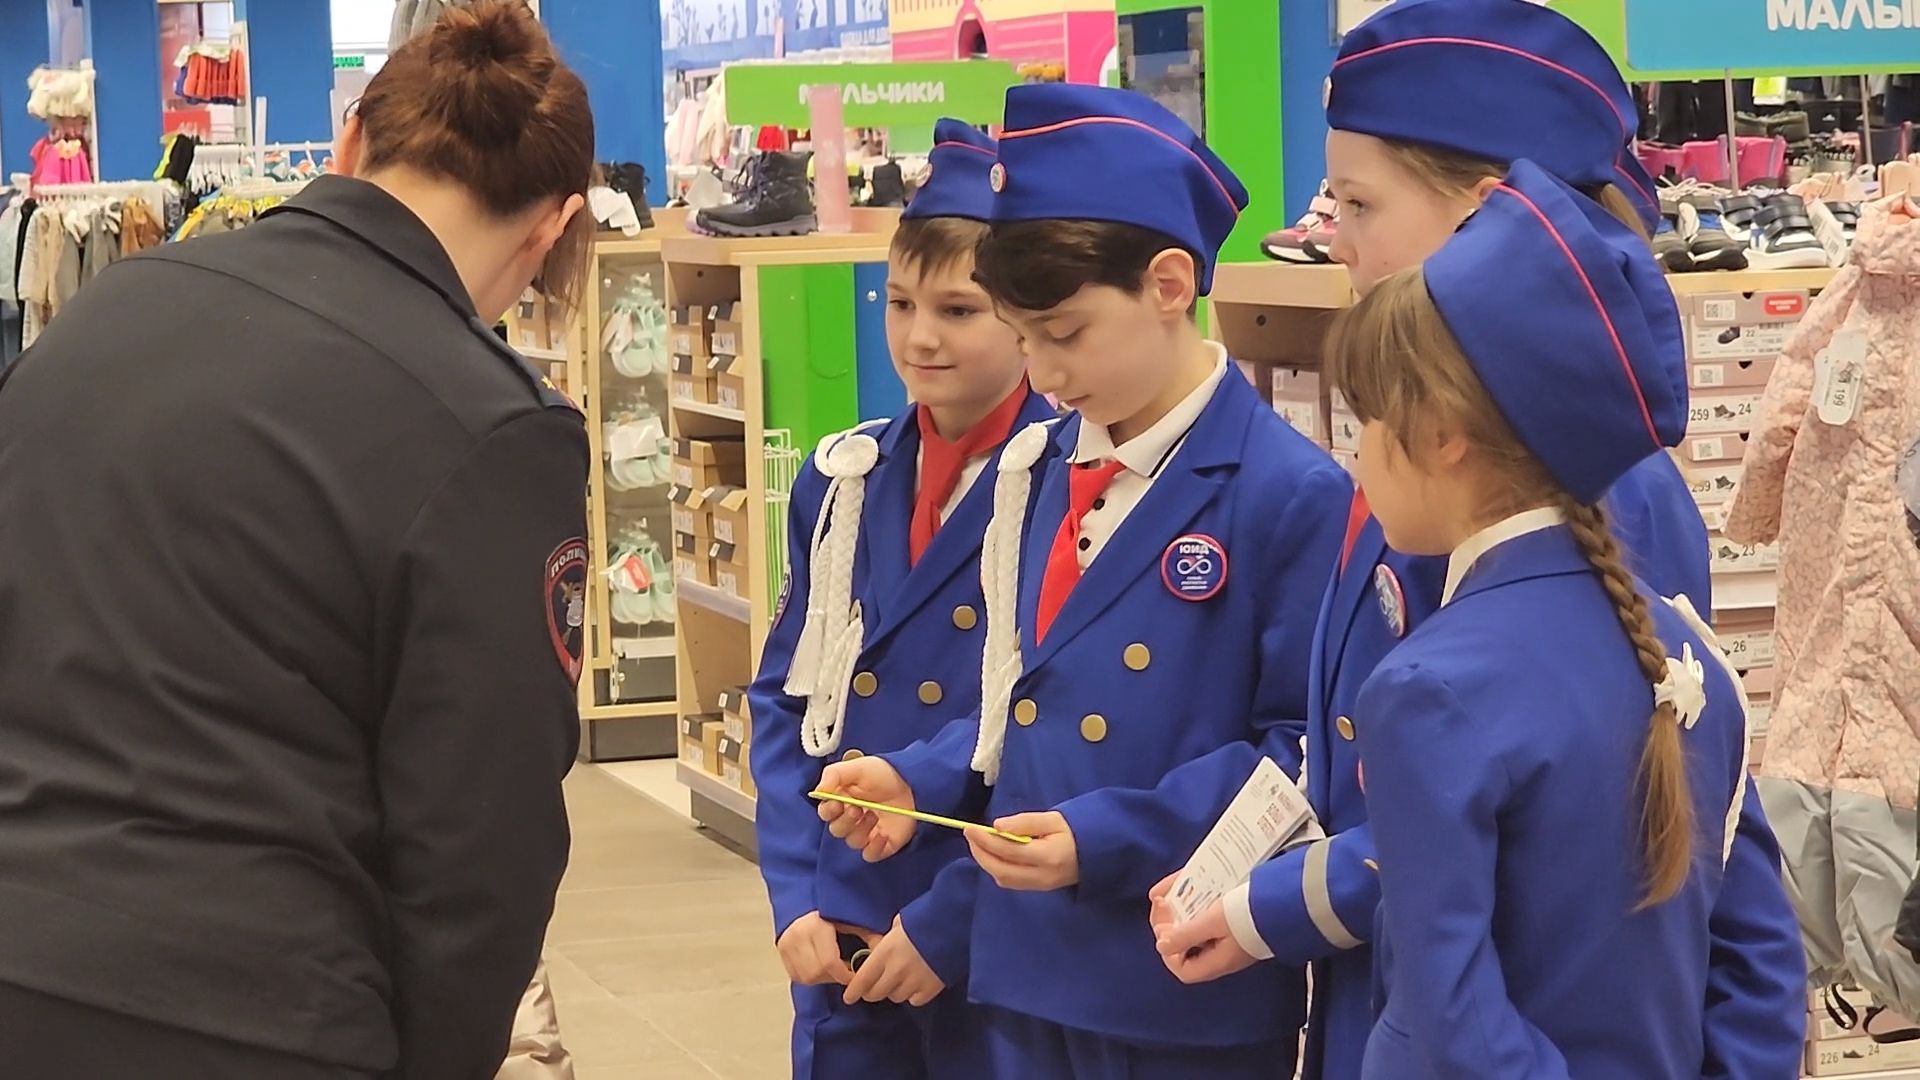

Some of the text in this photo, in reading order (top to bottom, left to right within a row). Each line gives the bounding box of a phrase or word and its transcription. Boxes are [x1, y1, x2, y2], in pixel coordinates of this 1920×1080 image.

[1690, 408, 1709, 421] 259
[1738, 403, 1752, 415] 24
[1742, 544, 1756, 556] 23
[1733, 641, 1747, 653] 26
[1868, 1044, 1880, 1055] 24
[1820, 1053, 1839, 1064] 226
